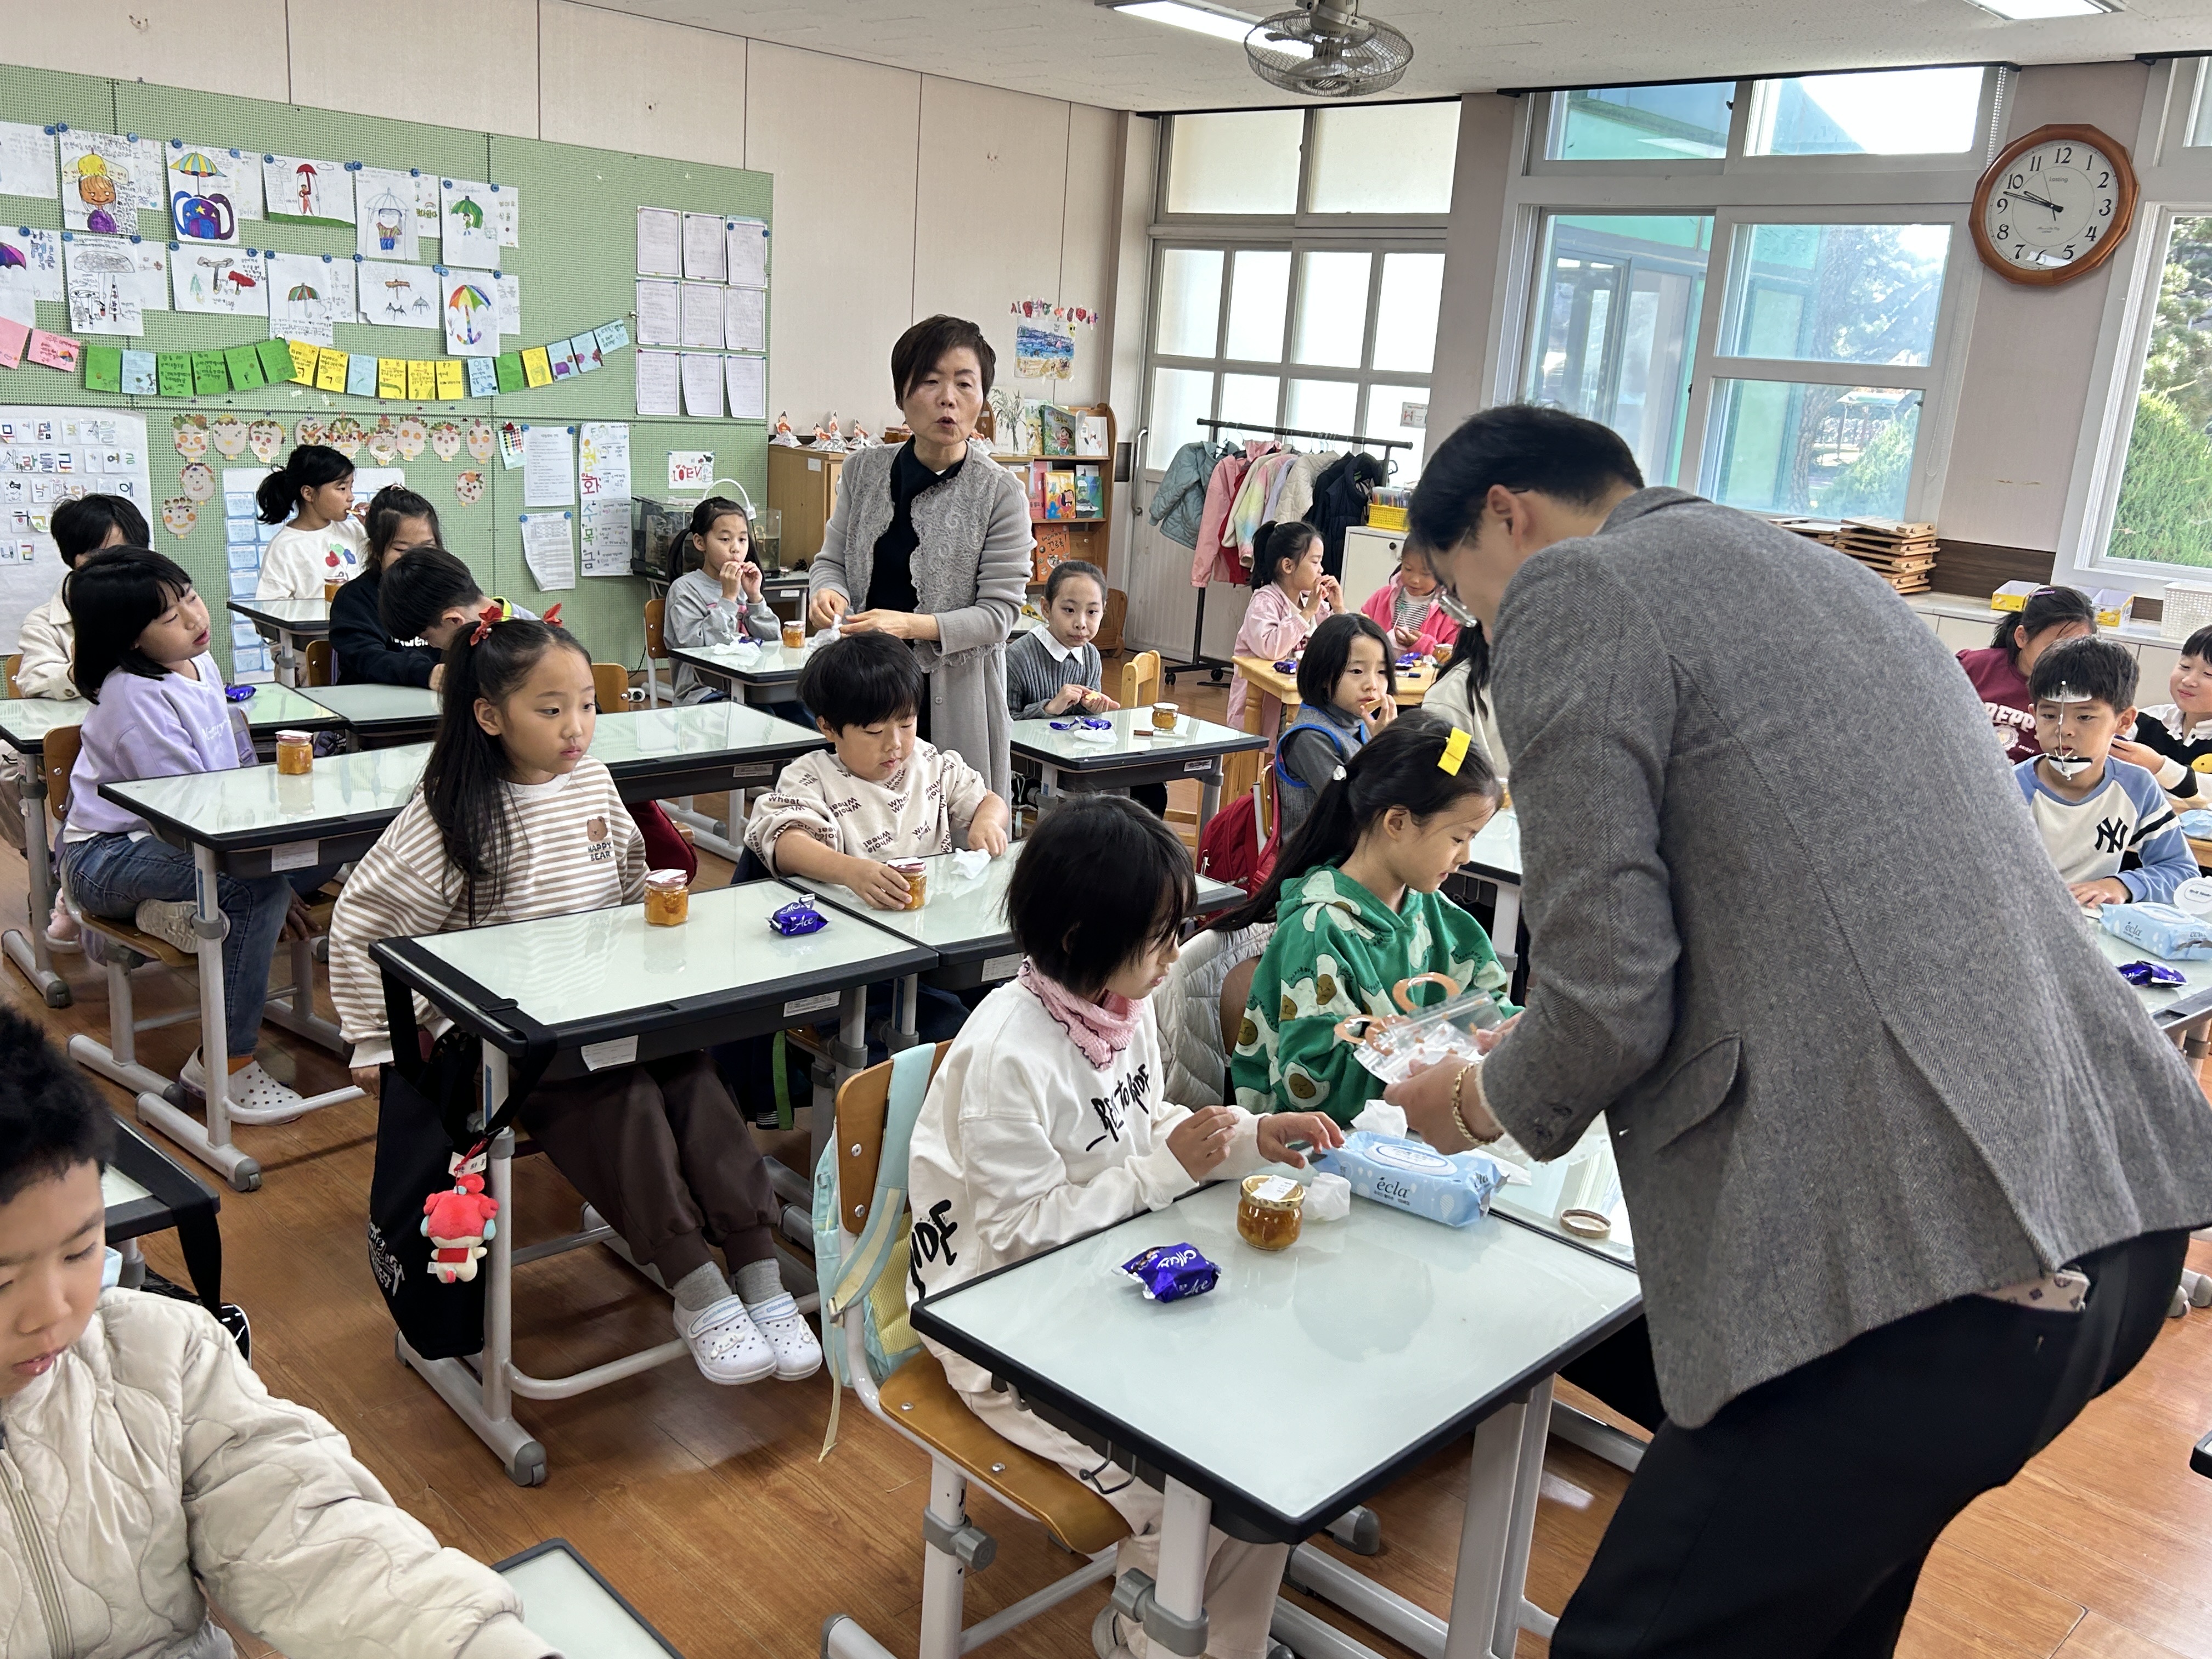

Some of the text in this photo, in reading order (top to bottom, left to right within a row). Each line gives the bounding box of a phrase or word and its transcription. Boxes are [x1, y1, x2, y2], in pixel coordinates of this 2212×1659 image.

[2030, 156, 2042, 171] 11
[2055, 147, 2072, 165] 12
[2086, 155, 2092, 170] 1
[2007, 174, 2023, 189] 10
[2097, 172, 2109, 188] 2
[1996, 198, 2008, 214] 9
[2098, 199, 2112, 216] 3
[1996, 224, 2009, 240] 8
[2085, 226, 2097, 241] 4
[2014, 244, 2025, 259] 7
[2062, 244, 2076, 259] 5
[582, 473, 599, 494] 화
[582, 504, 597, 522] 수
[583, 528, 594, 545] 목
[582, 552, 595, 569] 금
[769, 796, 799, 804] Wheat
[830, 797, 857, 812] Wheat
[834, 803, 861, 817] Whole
[863, 831, 890, 848] Wheat
[2095, 816, 2128, 853] NY
[588, 842, 611, 853] HAPPY
[867, 836, 893, 853] Whole
[590, 851, 611, 861] BEAR
[790, 915, 815, 932] Ace
[1377, 1177, 1409, 1198] écla
